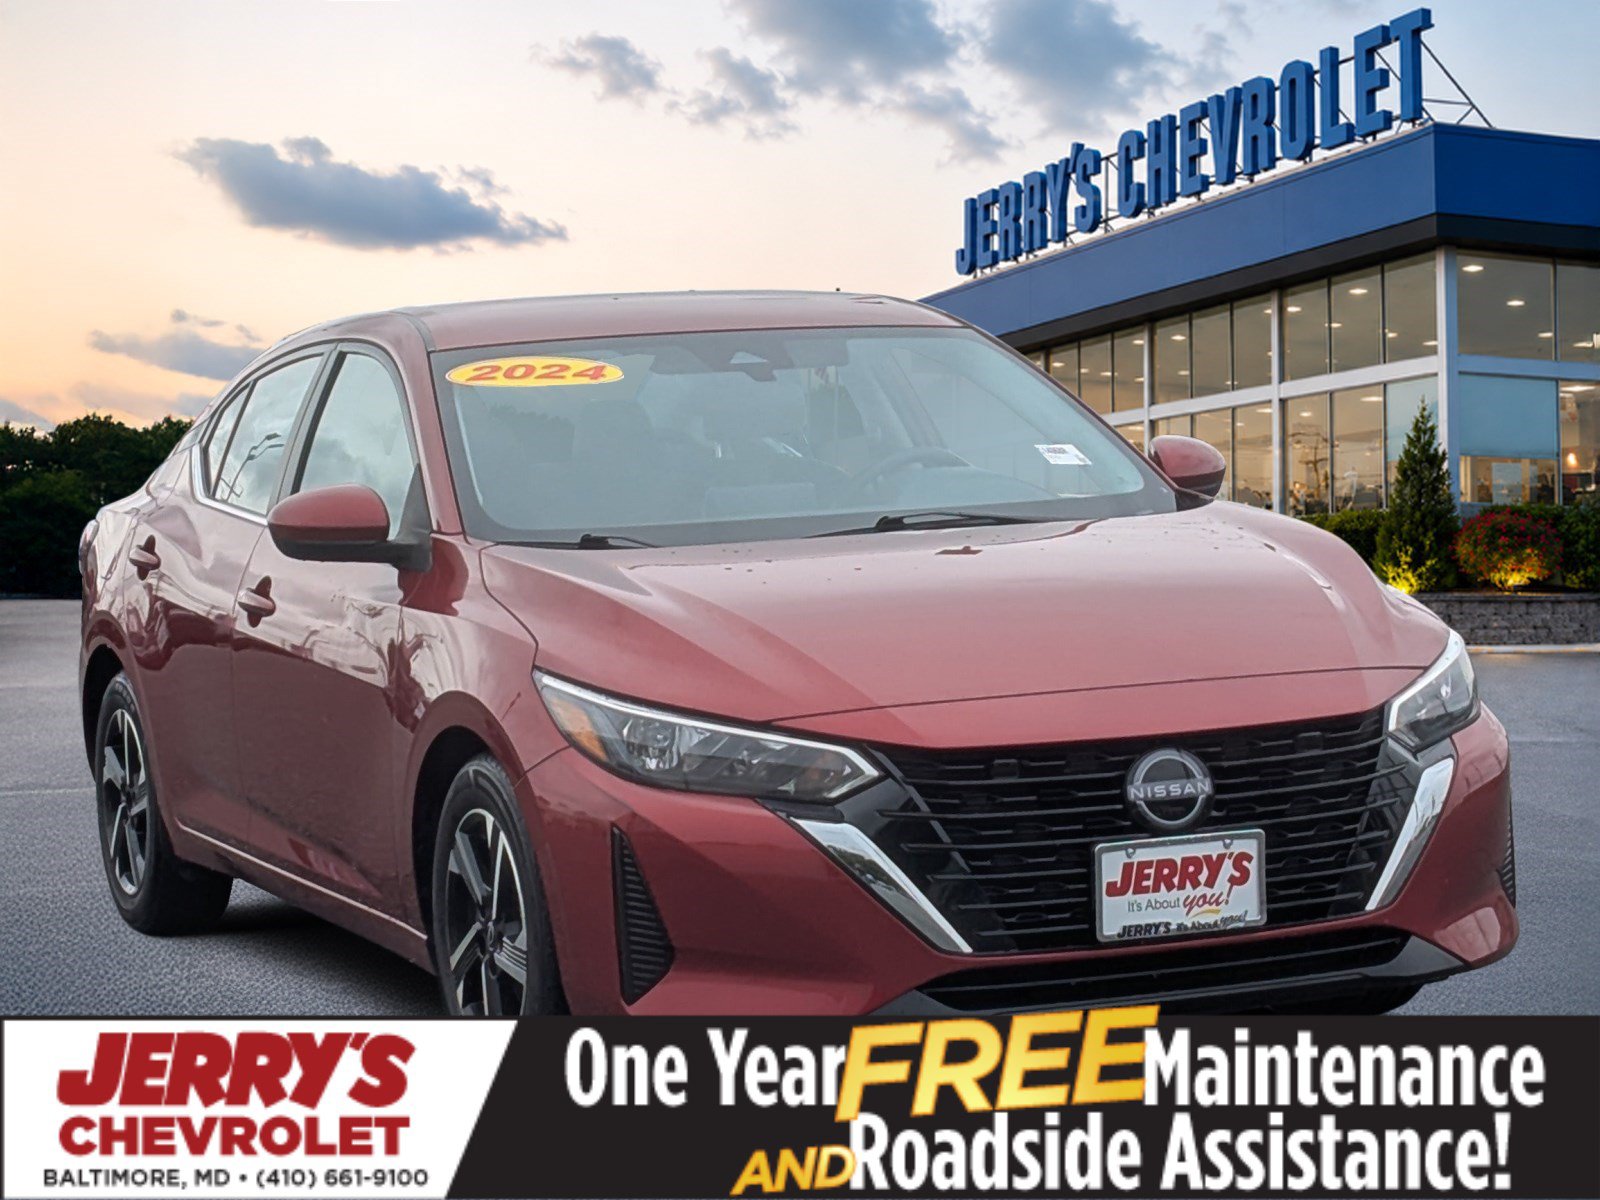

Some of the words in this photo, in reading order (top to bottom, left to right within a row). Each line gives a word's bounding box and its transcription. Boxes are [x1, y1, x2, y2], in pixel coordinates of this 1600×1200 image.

[956, 143, 1101, 276] JERRY'S
[1117, 8, 1434, 218] CHEVROLET
[466, 364, 607, 381] 2024
[1129, 782, 1211, 800] NISSAN
[1105, 851, 1254, 897] JERRY'S
[1127, 900, 1143, 912] It's
[1145, 897, 1180, 911] About
[1182, 885, 1234, 917] you!
[1117, 921, 1172, 938] JERRY'S
